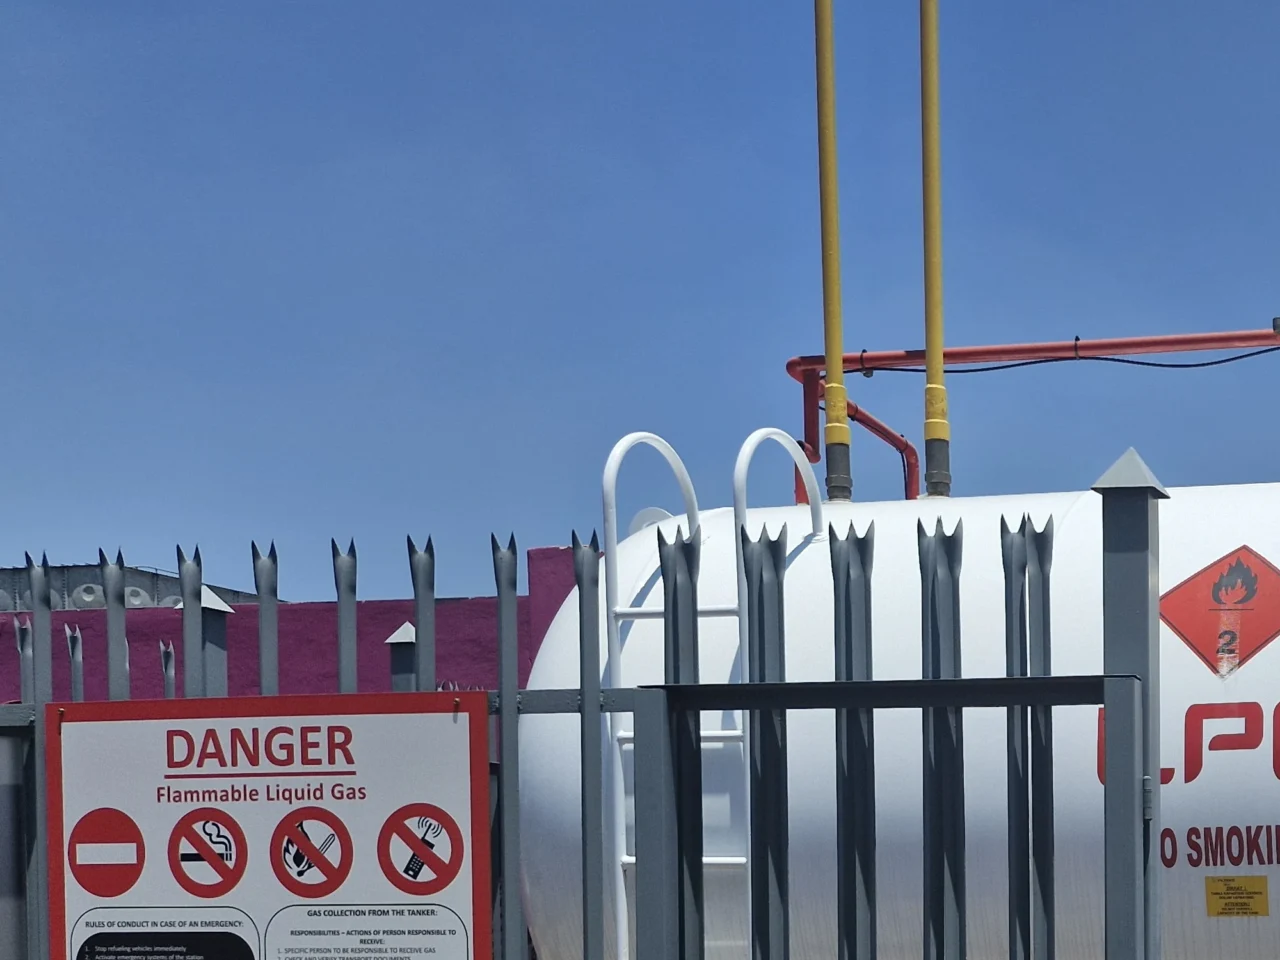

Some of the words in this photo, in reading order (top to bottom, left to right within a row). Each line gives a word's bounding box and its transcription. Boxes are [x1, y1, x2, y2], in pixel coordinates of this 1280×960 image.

[1216, 630, 1238, 656] 2
[166, 725, 355, 768] DANGER
[157, 784, 259, 803] Flammable
[266, 783, 323, 804] Liquid
[331, 783, 366, 800] Gas
